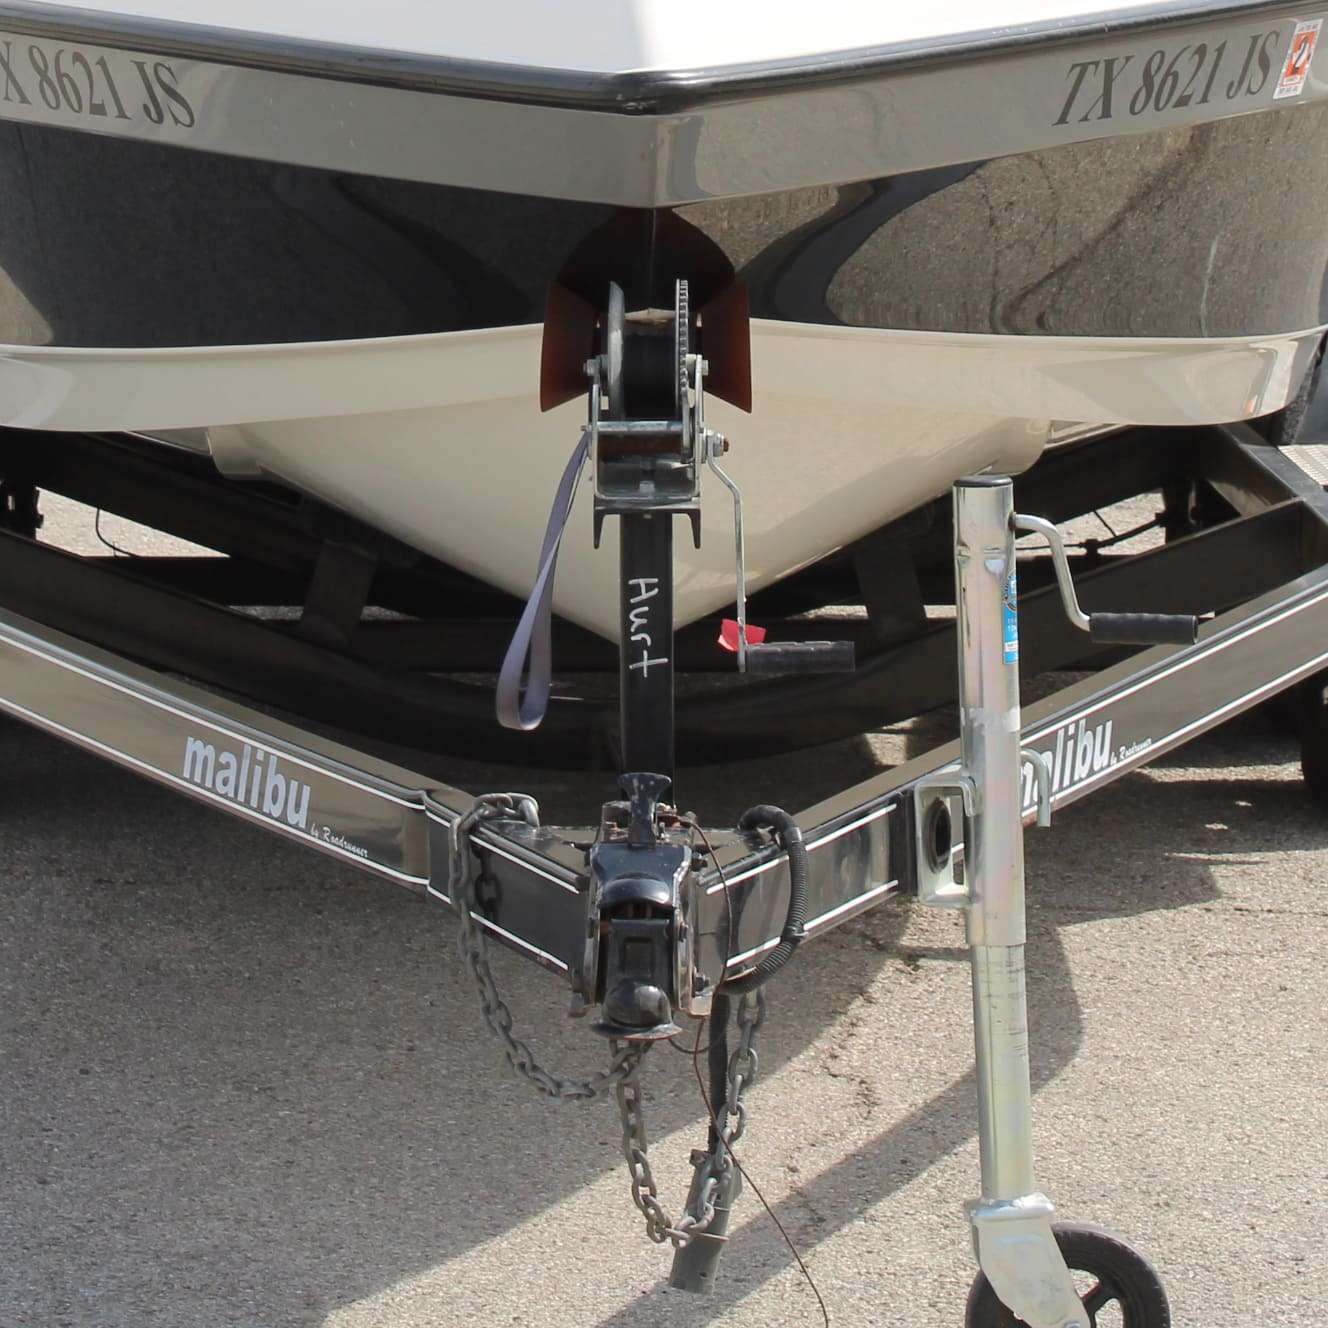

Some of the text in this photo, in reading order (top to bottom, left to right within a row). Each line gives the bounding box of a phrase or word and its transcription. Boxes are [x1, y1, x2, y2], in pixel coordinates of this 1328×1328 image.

[28, 45, 133, 120] 8621
[129, 59, 195, 128] JS
[1051, 29, 1280, 127] TX 8621 JS
[183, 736, 311, 828] malibu
[1021, 718, 1113, 808] libu
